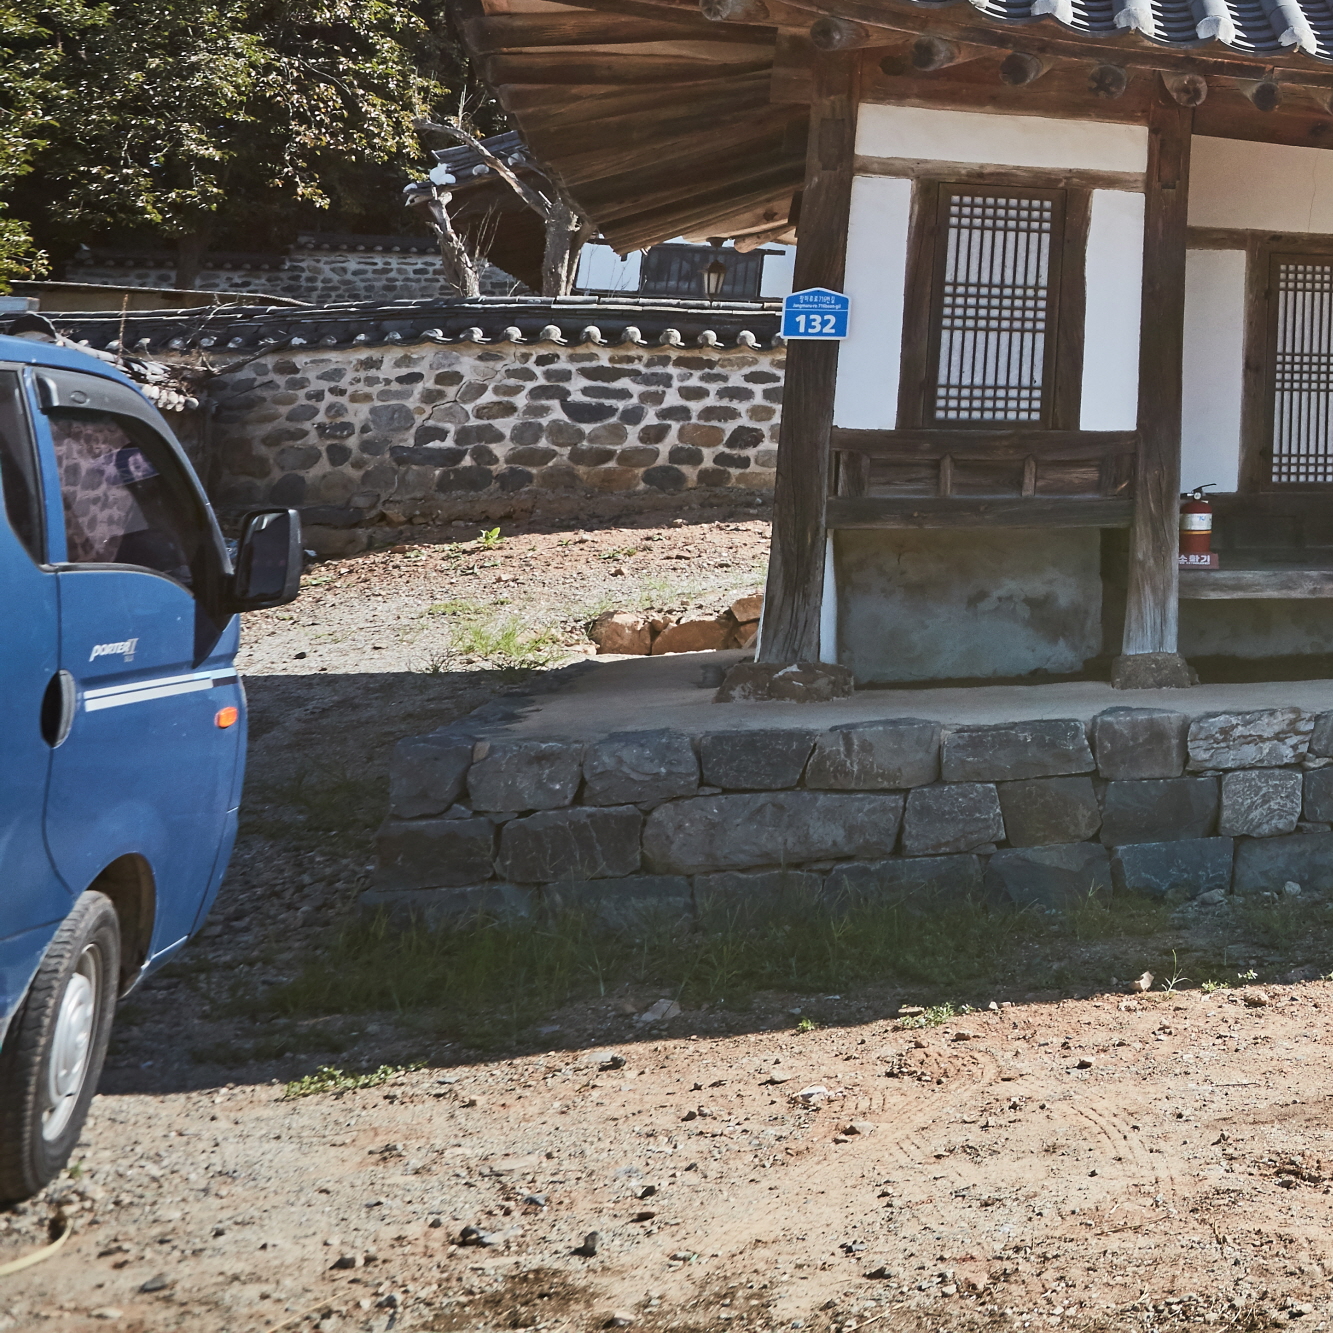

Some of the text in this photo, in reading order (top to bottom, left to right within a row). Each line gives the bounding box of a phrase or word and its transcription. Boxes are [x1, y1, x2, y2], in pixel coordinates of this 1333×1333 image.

[795, 314, 836, 333] 132
[1178, 554, 1210, 563] 소화기
[89, 641, 130, 662] PORTER
